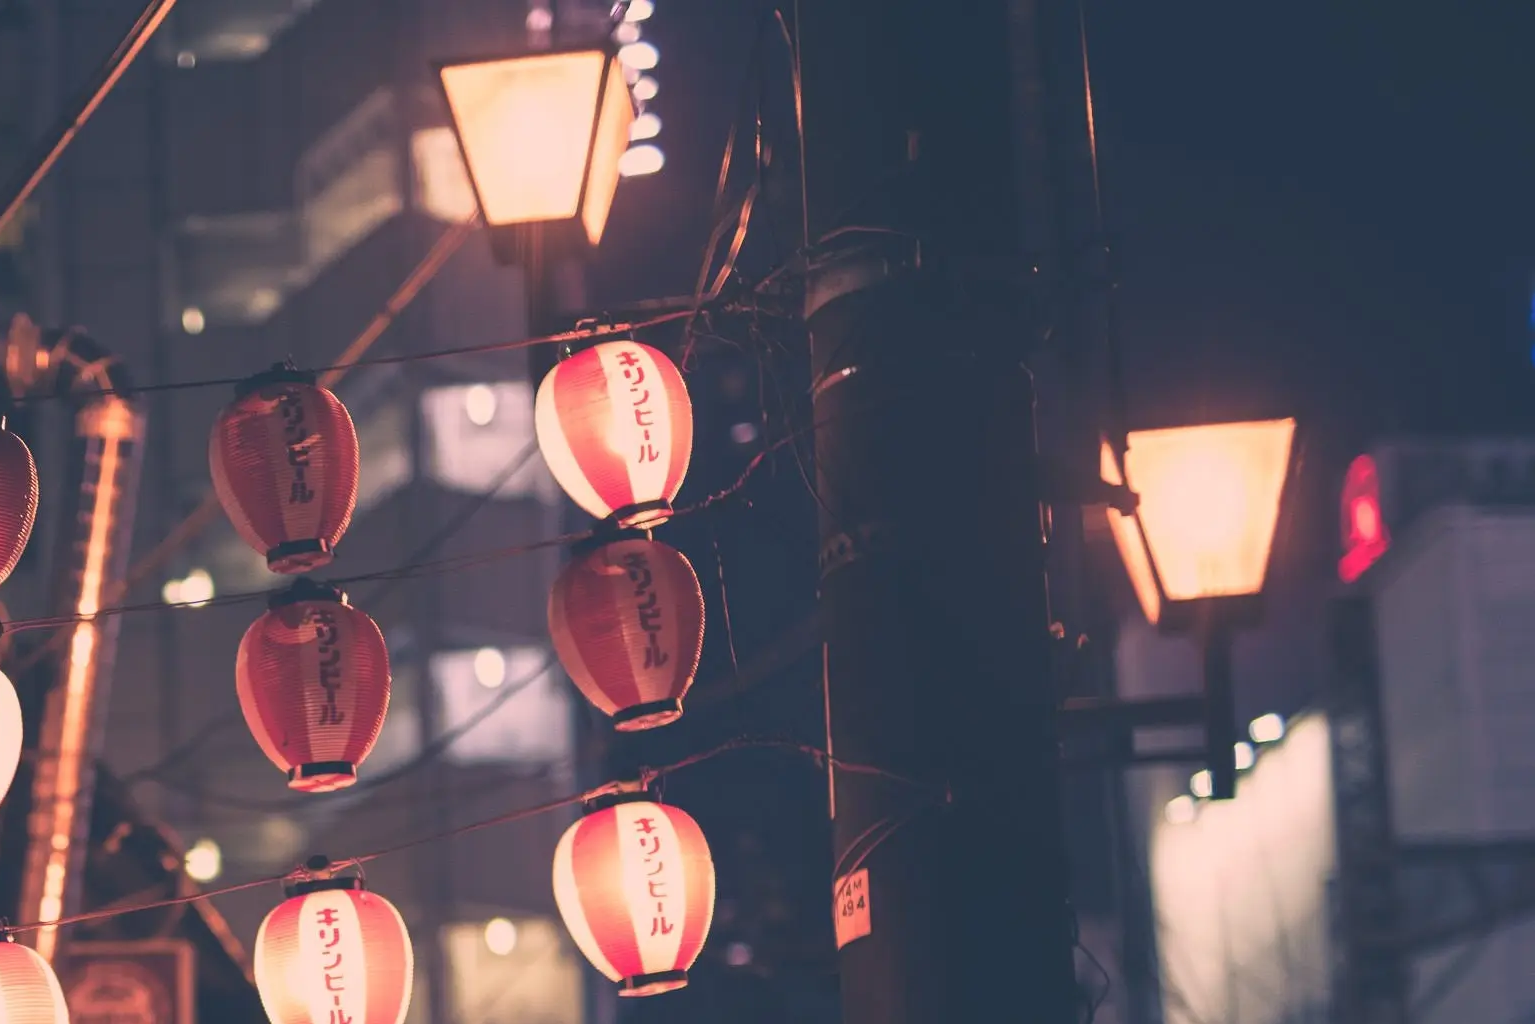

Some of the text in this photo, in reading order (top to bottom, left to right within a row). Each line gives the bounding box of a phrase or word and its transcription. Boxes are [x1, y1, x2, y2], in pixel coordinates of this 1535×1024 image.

[618, 351, 659, 463] キリンビール
[314, 608, 345, 726] キリンビール
[624, 551, 669, 671] キリンビール
[633, 817, 674, 937] キリンビール
